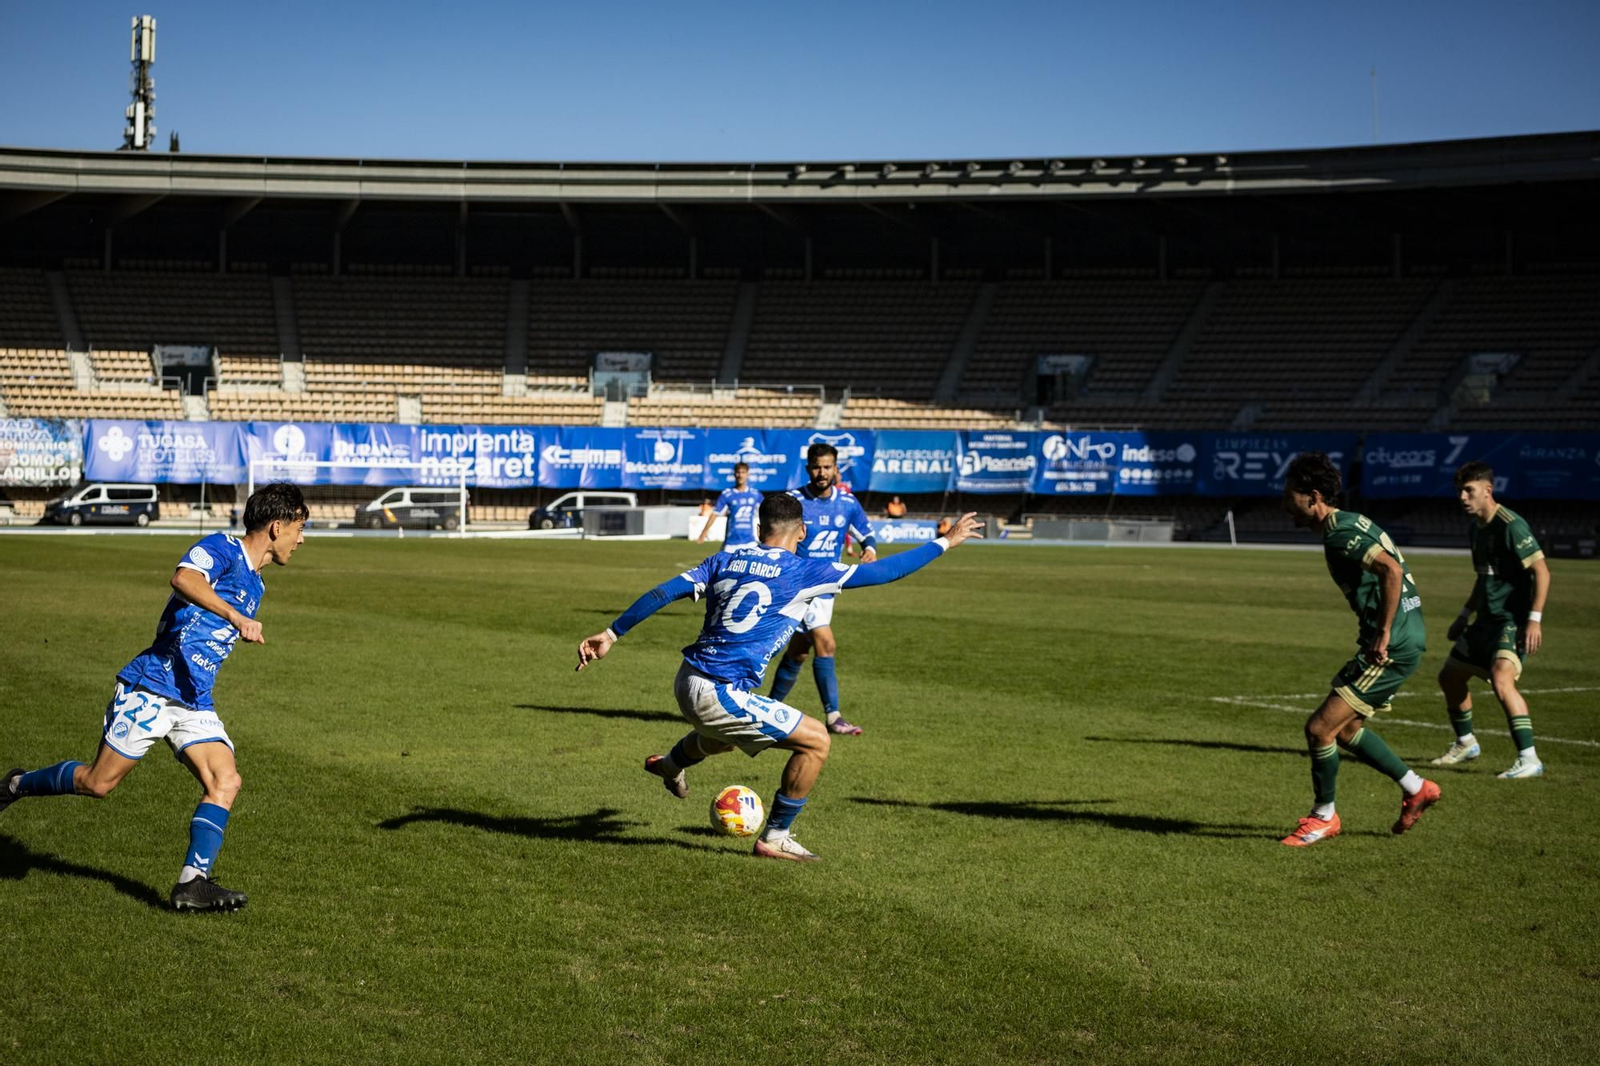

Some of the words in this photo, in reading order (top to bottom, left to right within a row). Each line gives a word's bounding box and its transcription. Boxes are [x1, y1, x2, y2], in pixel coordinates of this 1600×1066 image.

[138, 435, 208, 449] TUGASA
[421, 429, 534, 459] imprenta
[10, 454, 65, 467] SOMOS
[139, 449, 215, 463] HOTELES
[742, 454, 786, 464] SPORTS
[421, 453, 534, 478] nazaret
[625, 461, 703, 475] Bricopinturas
[873, 459, 953, 473] ARENAL
[749, 562, 782, 578] GARCÍA
[713, 578, 773, 634] 10
[123, 693, 162, 733] 22
